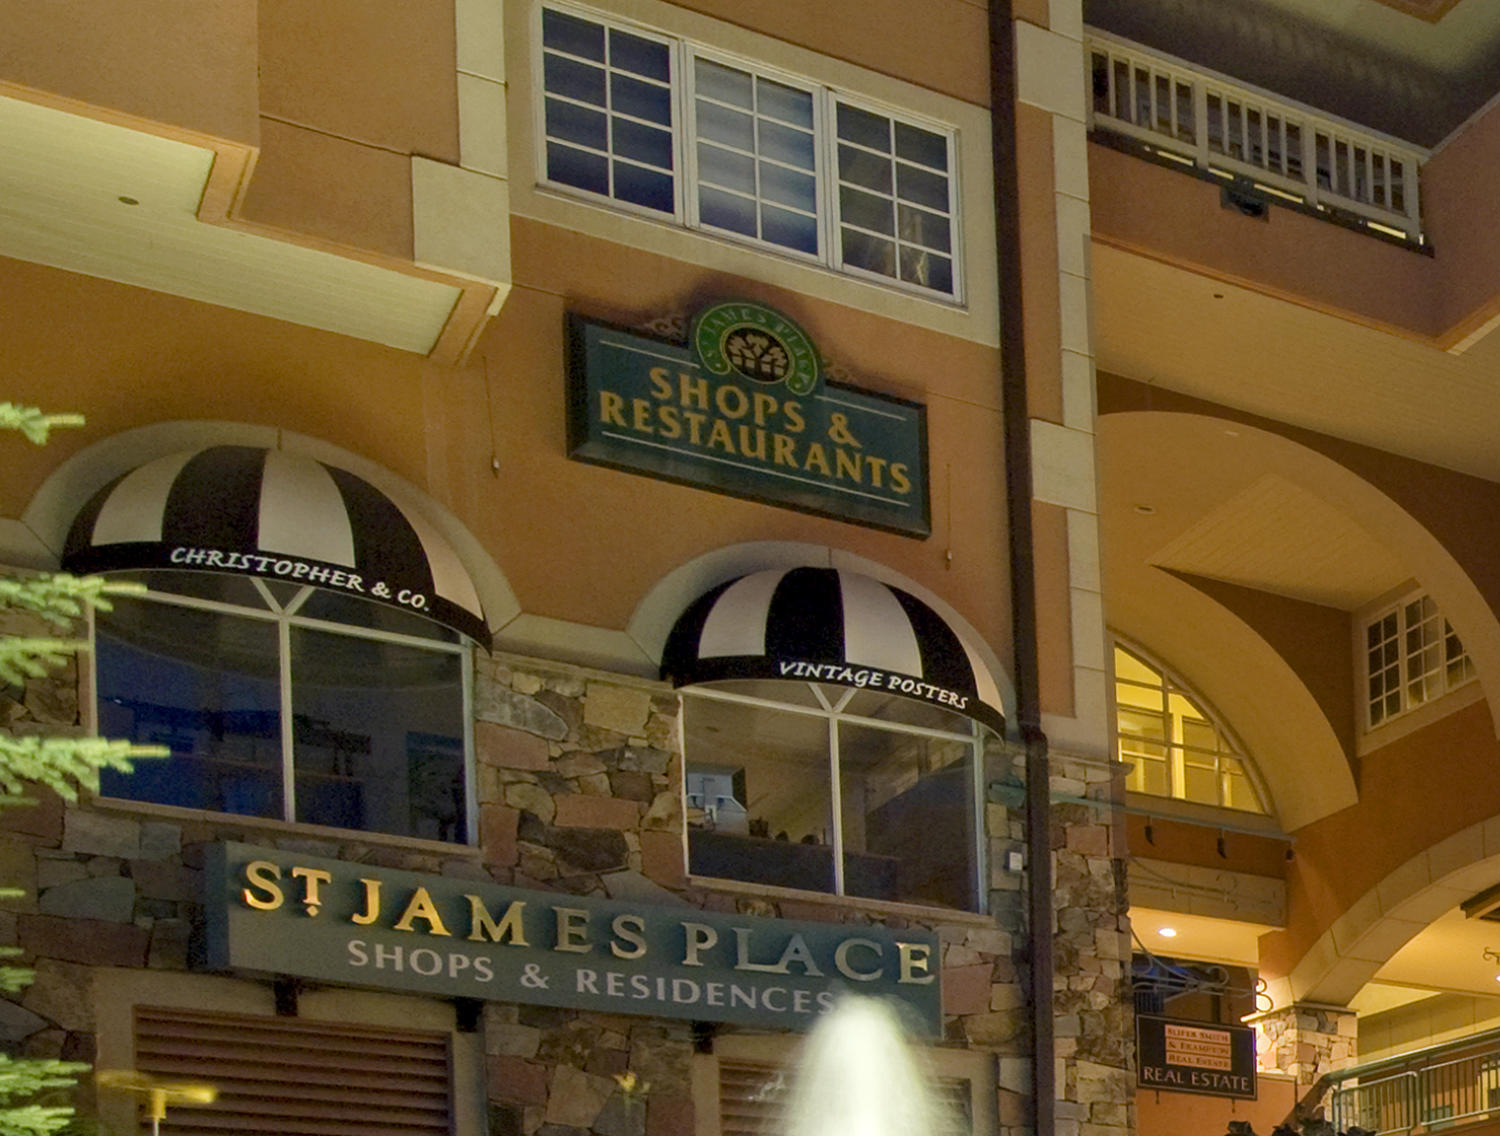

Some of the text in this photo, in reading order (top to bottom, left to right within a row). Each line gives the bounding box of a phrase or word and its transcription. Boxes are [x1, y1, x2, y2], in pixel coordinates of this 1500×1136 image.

[600, 390, 912, 494] RESTAURANTS
[649, 366, 862, 448] SHOPS &
[170, 547, 430, 612] CHRISTOPHER & CO.
[779, 661, 969, 710] VINTAGE POSTERS
[242, 860, 938, 986] ST JAMES PLACE
[346, 939, 837, 1016] SHOPS & RESIDENCES
[1144, 1067, 1250, 1090] REAL ESTATE
